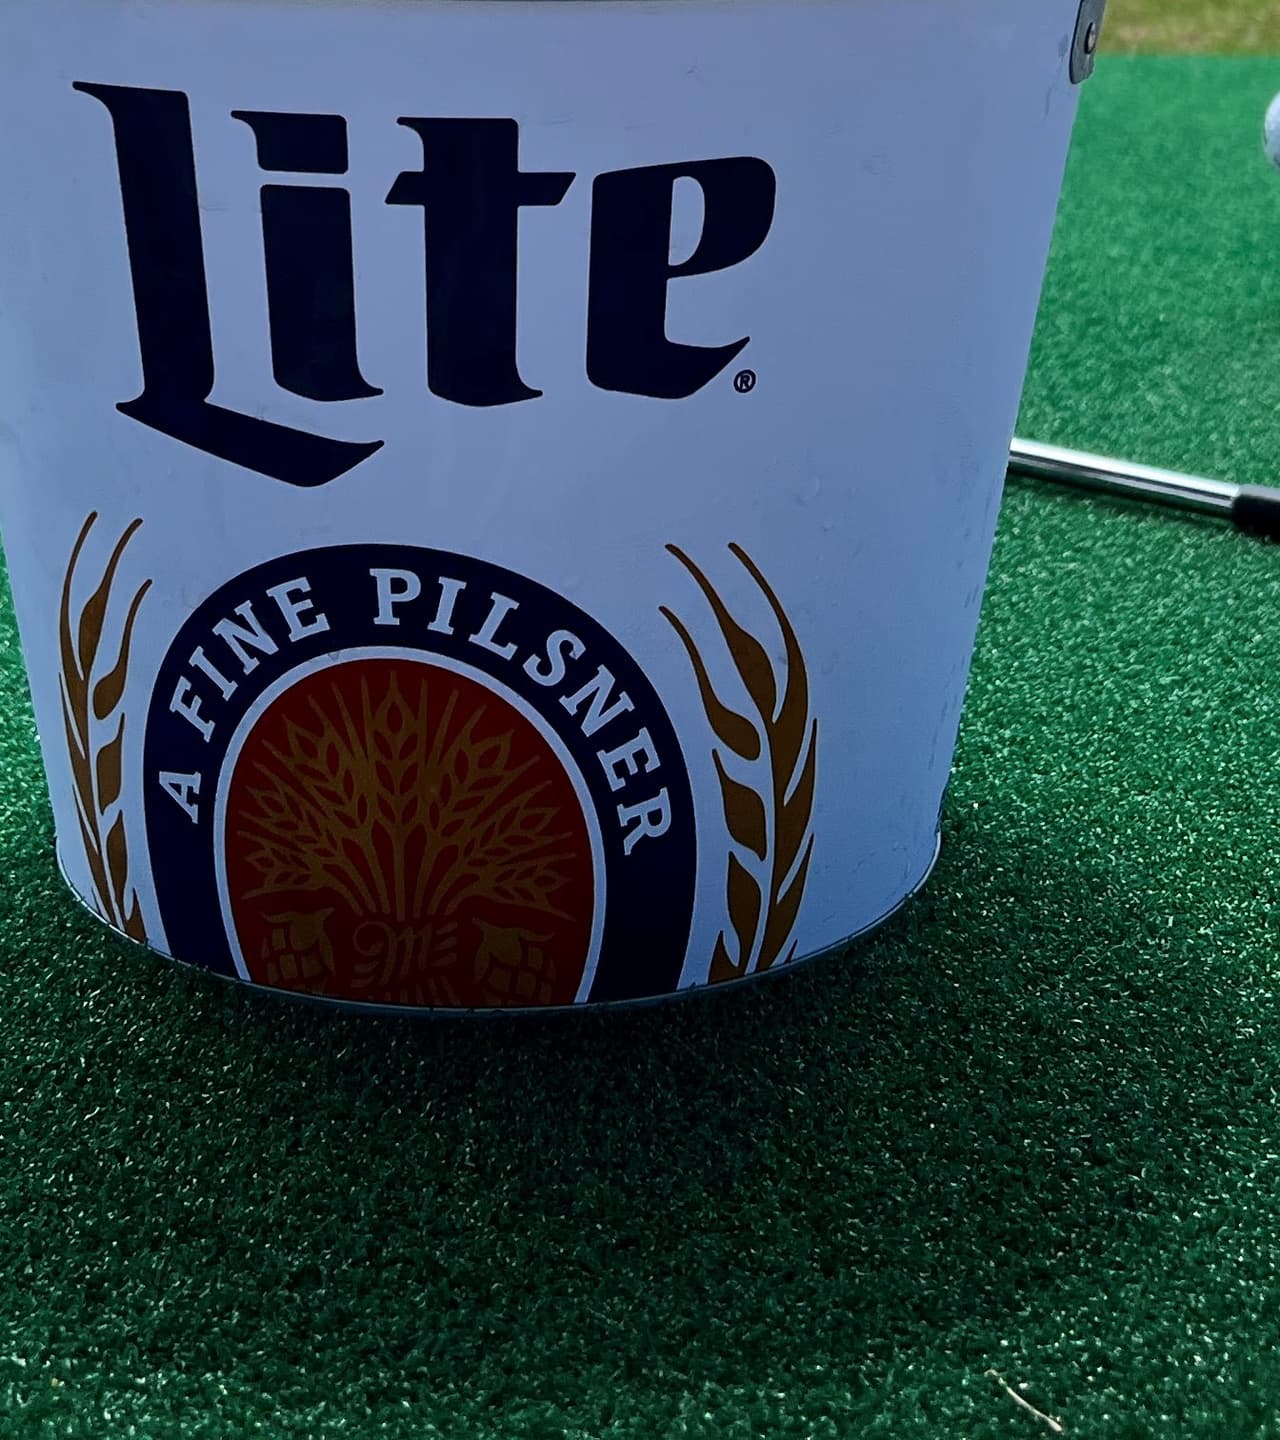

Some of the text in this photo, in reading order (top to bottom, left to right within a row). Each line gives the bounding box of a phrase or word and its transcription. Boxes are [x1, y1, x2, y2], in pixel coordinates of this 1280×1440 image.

[72, 80, 778, 488] Lite
[156, 566, 674, 857] A FINE PILSNER
